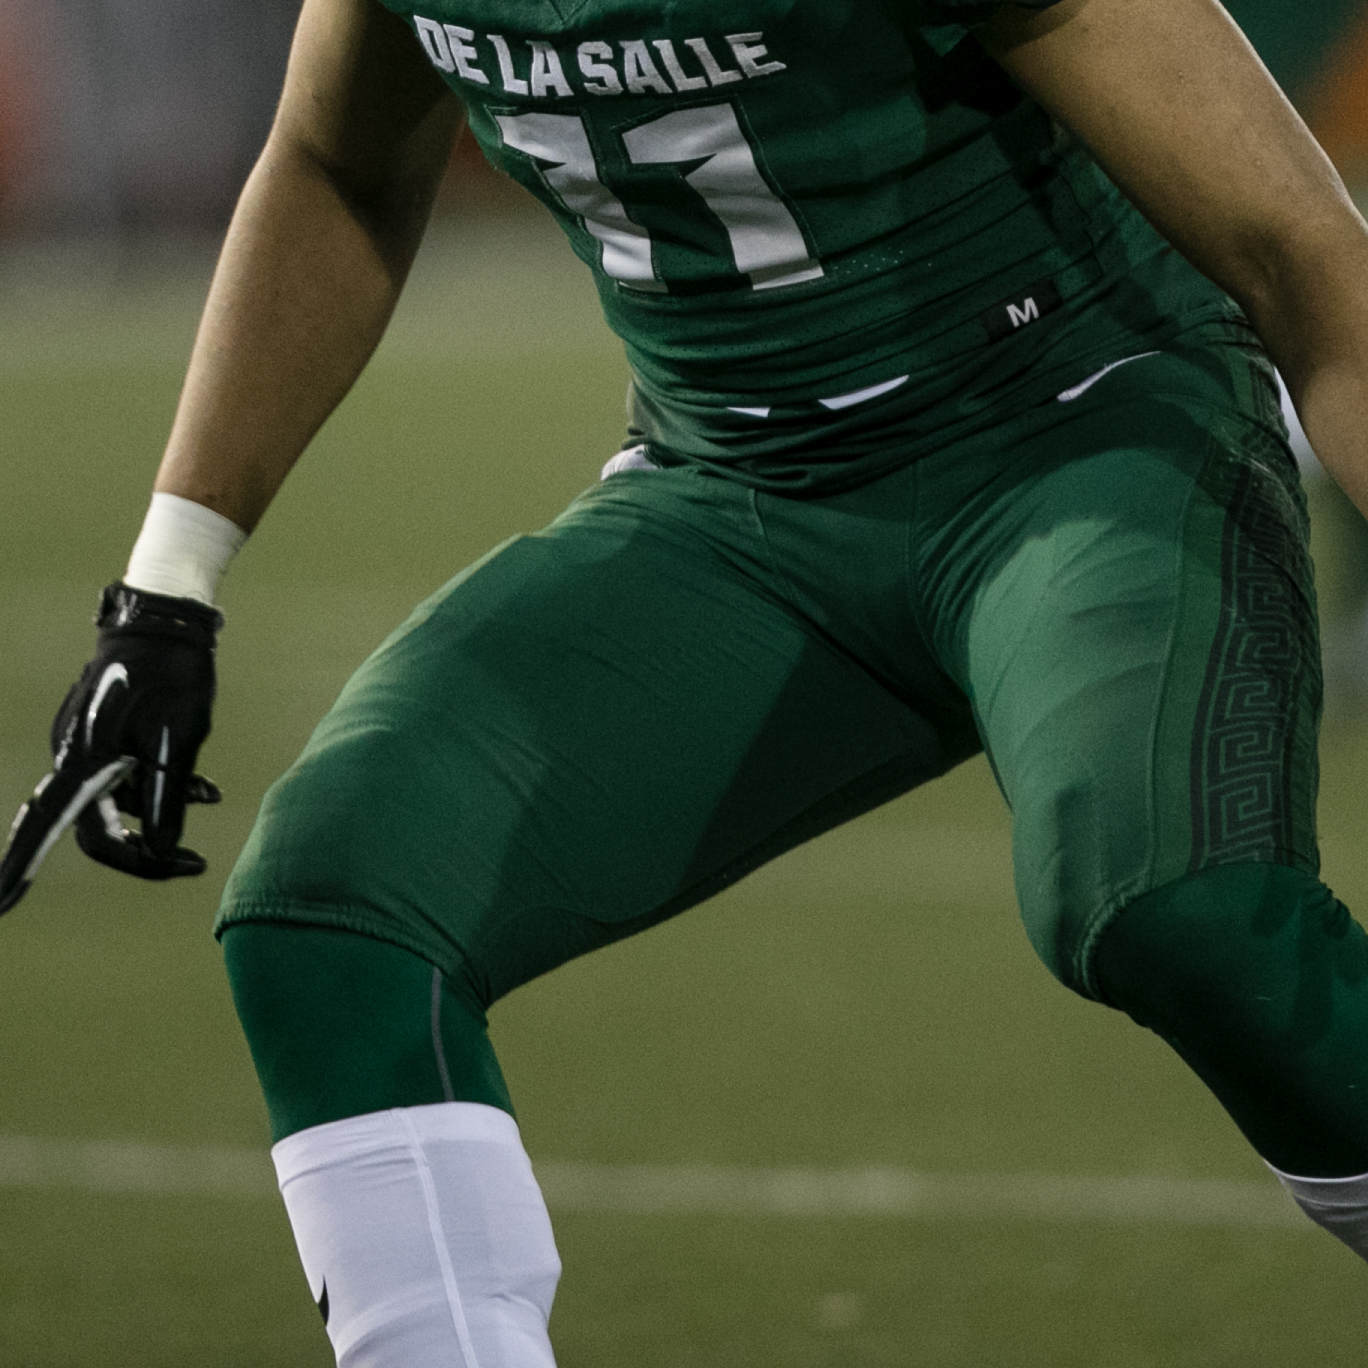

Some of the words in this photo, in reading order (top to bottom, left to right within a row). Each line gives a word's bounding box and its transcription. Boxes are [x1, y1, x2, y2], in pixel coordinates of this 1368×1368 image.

[413, 15, 489, 85] DE
[486, 34, 574, 97] LA
[578, 31, 787, 96] SALLE
[498, 102, 825, 295] 11
[1005, 296, 1040, 328] M
